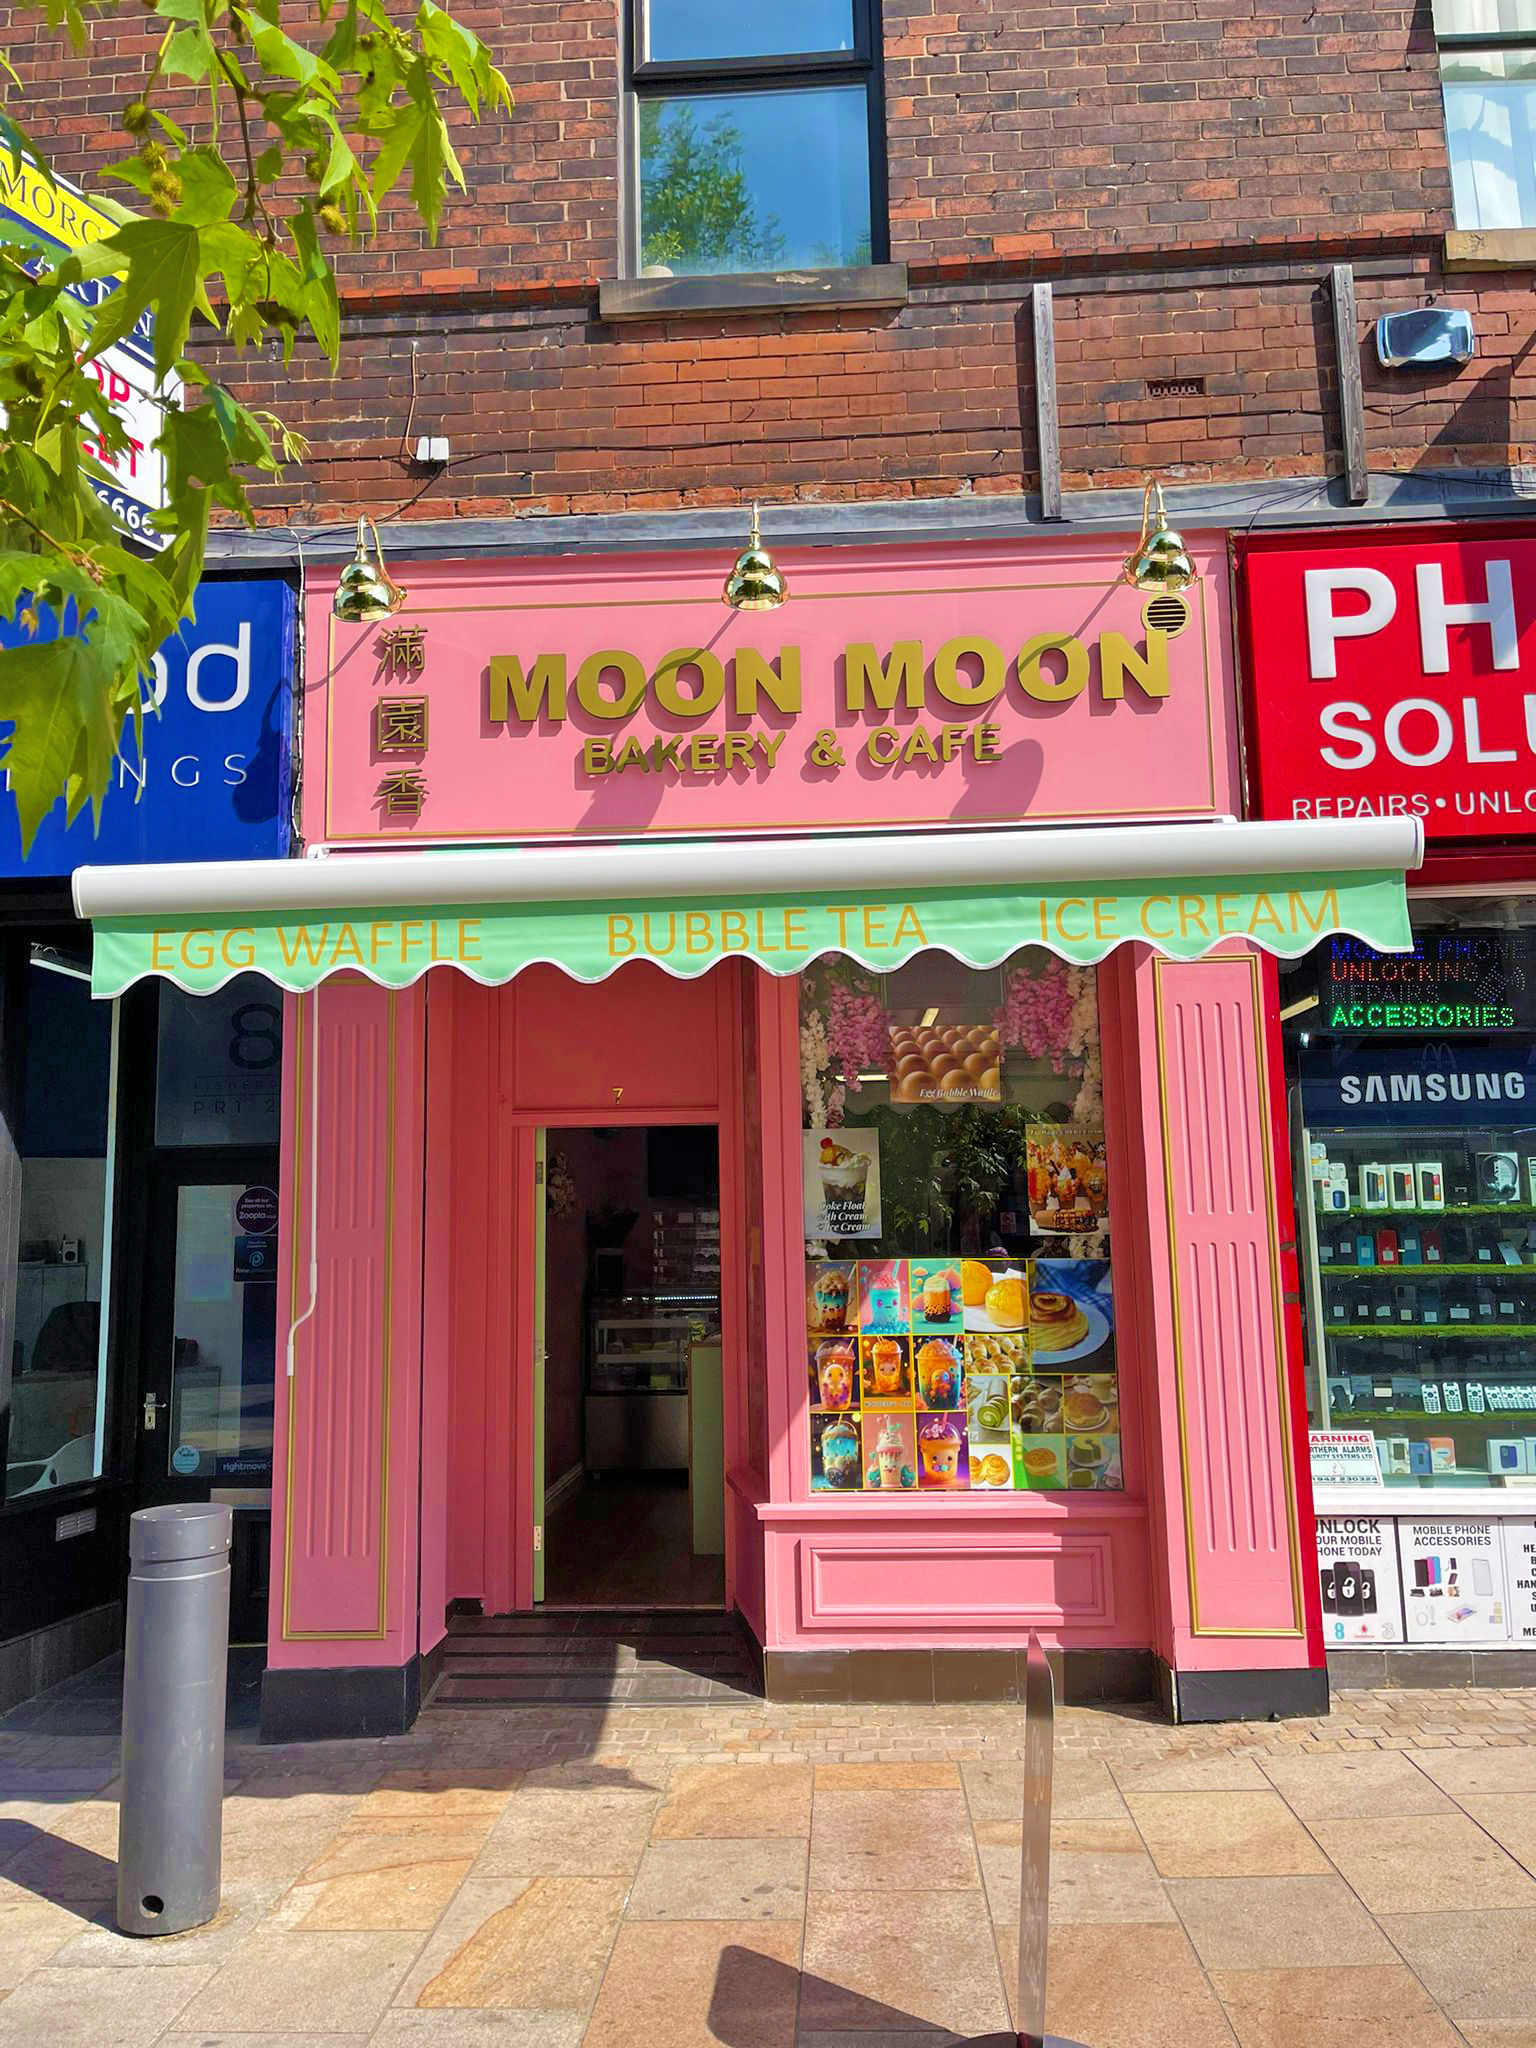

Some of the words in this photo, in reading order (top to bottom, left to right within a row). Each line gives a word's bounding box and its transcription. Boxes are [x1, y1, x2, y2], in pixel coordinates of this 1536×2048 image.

[1304, 559, 1520, 679] PH
[489, 645, 802, 722] MOON
[845, 629, 1171, 712] MOON
[1319, 694, 1536, 770] SOL
[583, 731, 786, 775] BAKERY
[811, 728, 846, 767] &
[867, 724, 1004, 764] CAFE
[1292, 793, 1430, 821] REPAIRS
[151, 928, 257, 971] EGG
[277, 919, 483, 967] WAFFLE
[607, 908, 810, 957] BUBBLE
[827, 905, 929, 949] TEA
[1039, 896, 1121, 942] ICE
[1140, 887, 1341, 938] CREAM
[1438, 938, 1528, 960] PHONE
[1331, 961, 1479, 983] UNLOCKING
[1331, 1006, 1515, 1028] ACCESSORIES
[612, 1087, 624, 1105] 7
[920, 1088, 936, 1099] Egg
[936, 1087, 968, 1097] Bubble
[1340, 1071, 1526, 1104] SAMSUNG
[1343, 1446, 1372, 1454] ALARMS
[1340, 1535, 1382, 1545] MOBILE
[1413, 1526, 1452, 1535] MOBILE
[1454, 1525, 1491, 1534] PHONE
[1414, 1536, 1492, 1546] ACCESSORIES
[1348, 1547, 1383, 1556] TODAY
